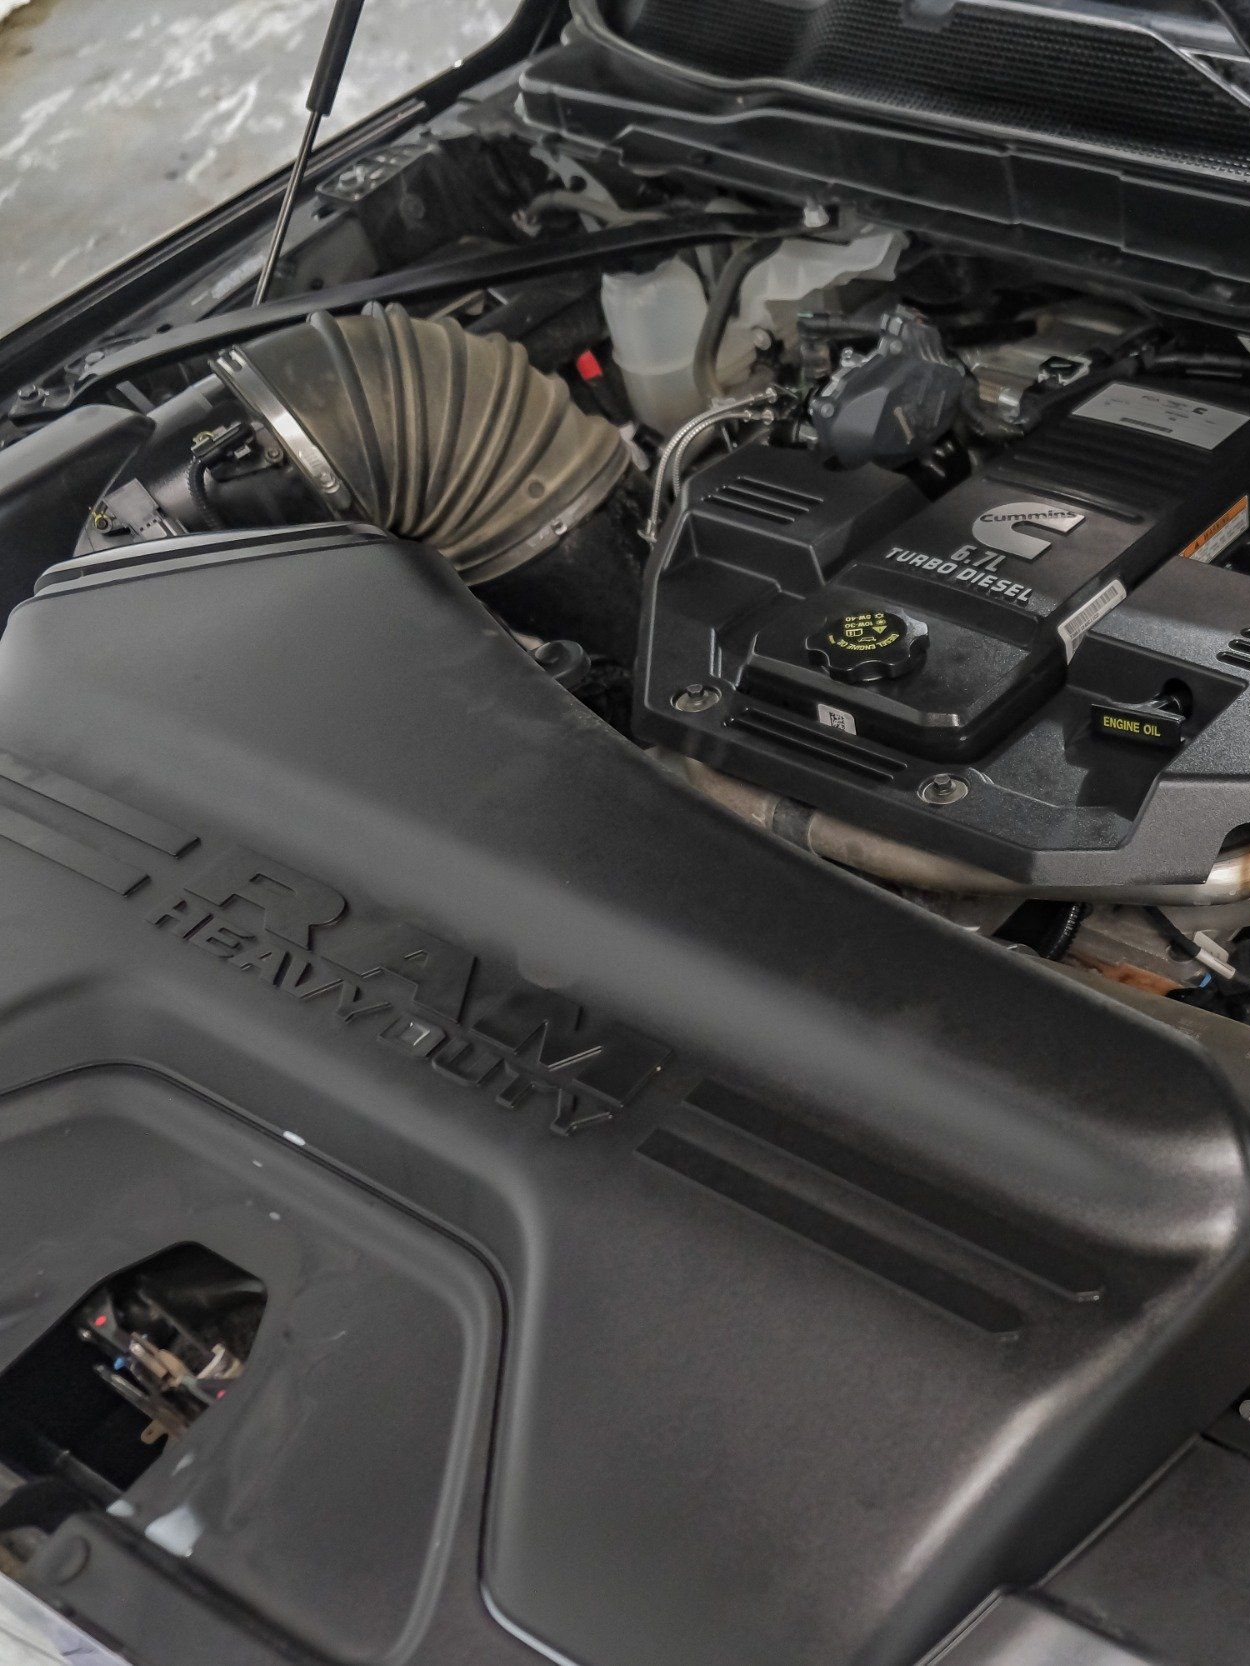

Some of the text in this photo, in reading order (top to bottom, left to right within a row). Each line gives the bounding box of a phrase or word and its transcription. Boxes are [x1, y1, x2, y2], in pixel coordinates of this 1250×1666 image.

[979, 509, 1079, 523] Cummins
[885, 547, 1033, 602] TURBO DIESEL
[950, 544, 1006, 573] 6.7L
[1103, 716, 1161, 737] ENGINE OIL
[183, 844, 674, 1109] RAM
[146, 898, 615, 1137] HEAVY DUTY
